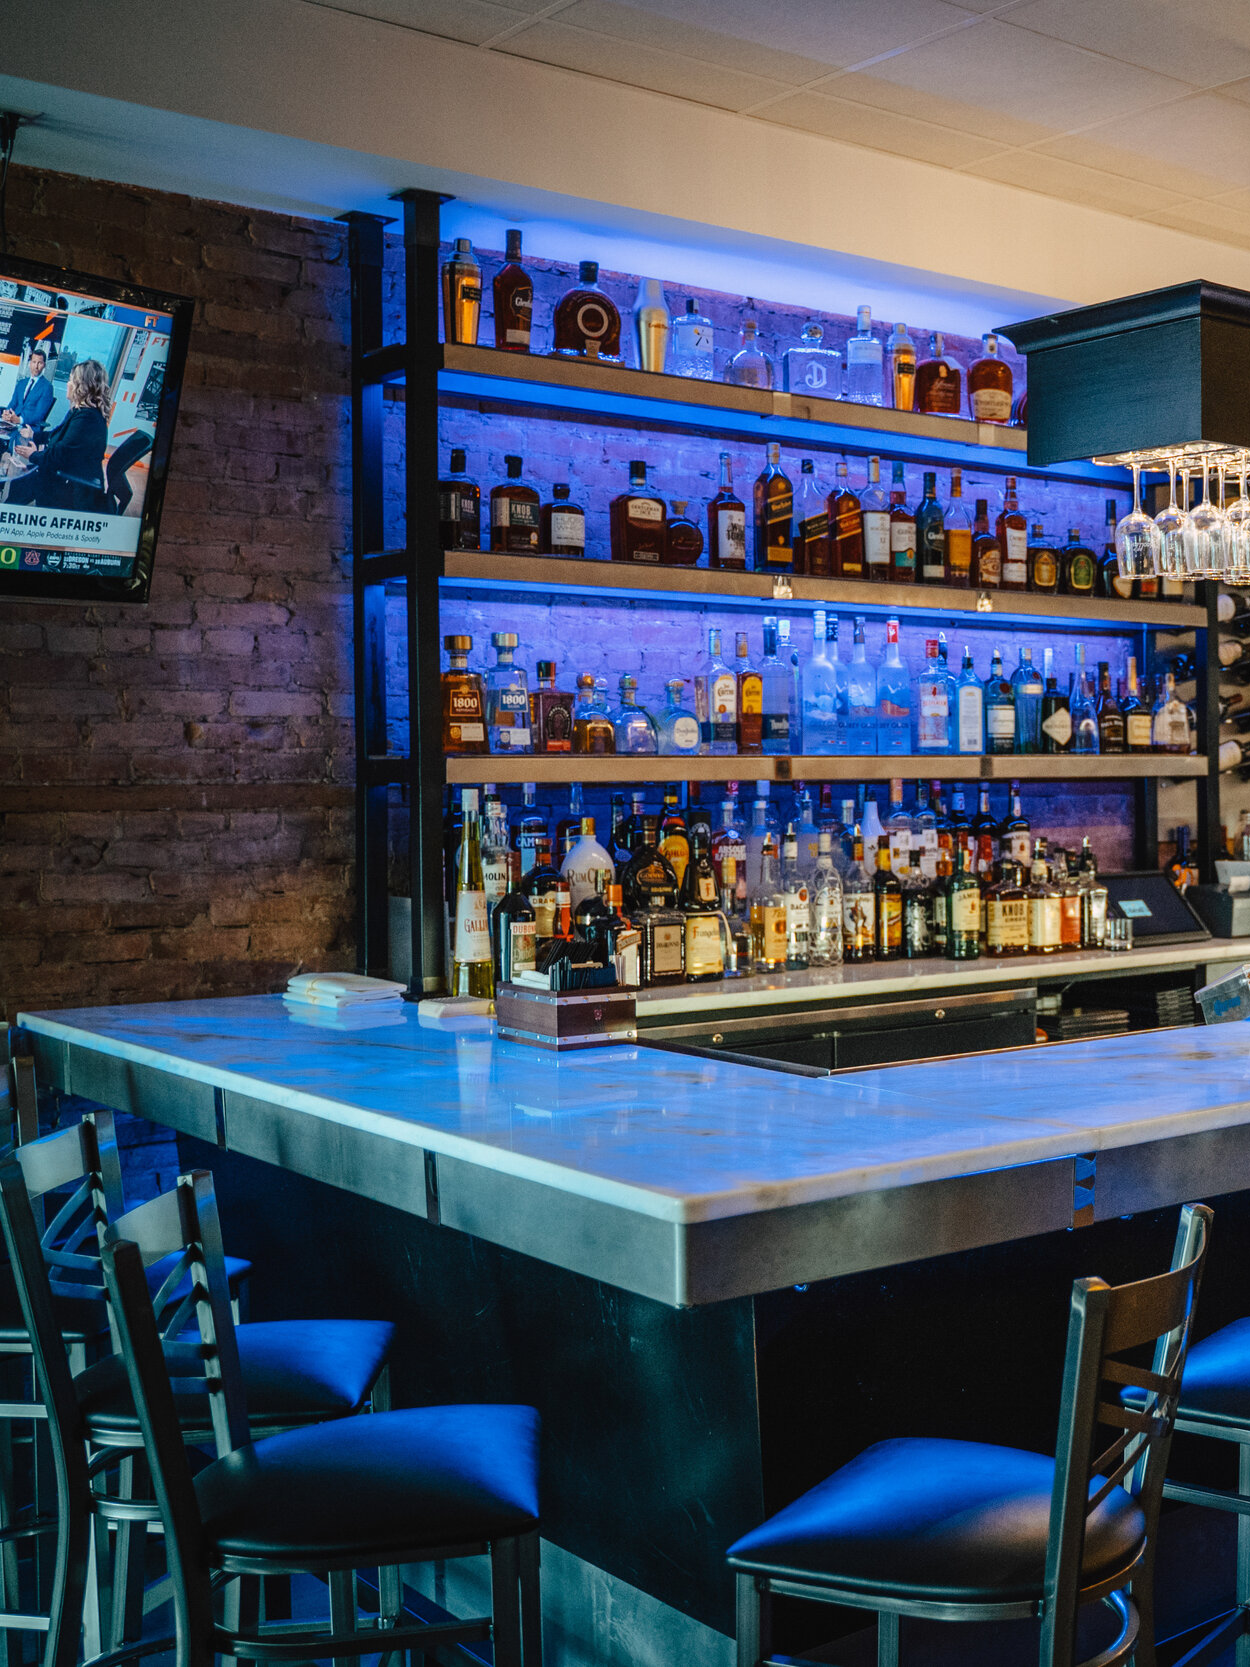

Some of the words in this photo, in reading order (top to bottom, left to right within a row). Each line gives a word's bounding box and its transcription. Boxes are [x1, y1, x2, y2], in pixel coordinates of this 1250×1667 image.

[511, 503, 531, 515] KNOB
[453, 697, 478, 708] 1800
[502, 694, 526, 705] 1800
